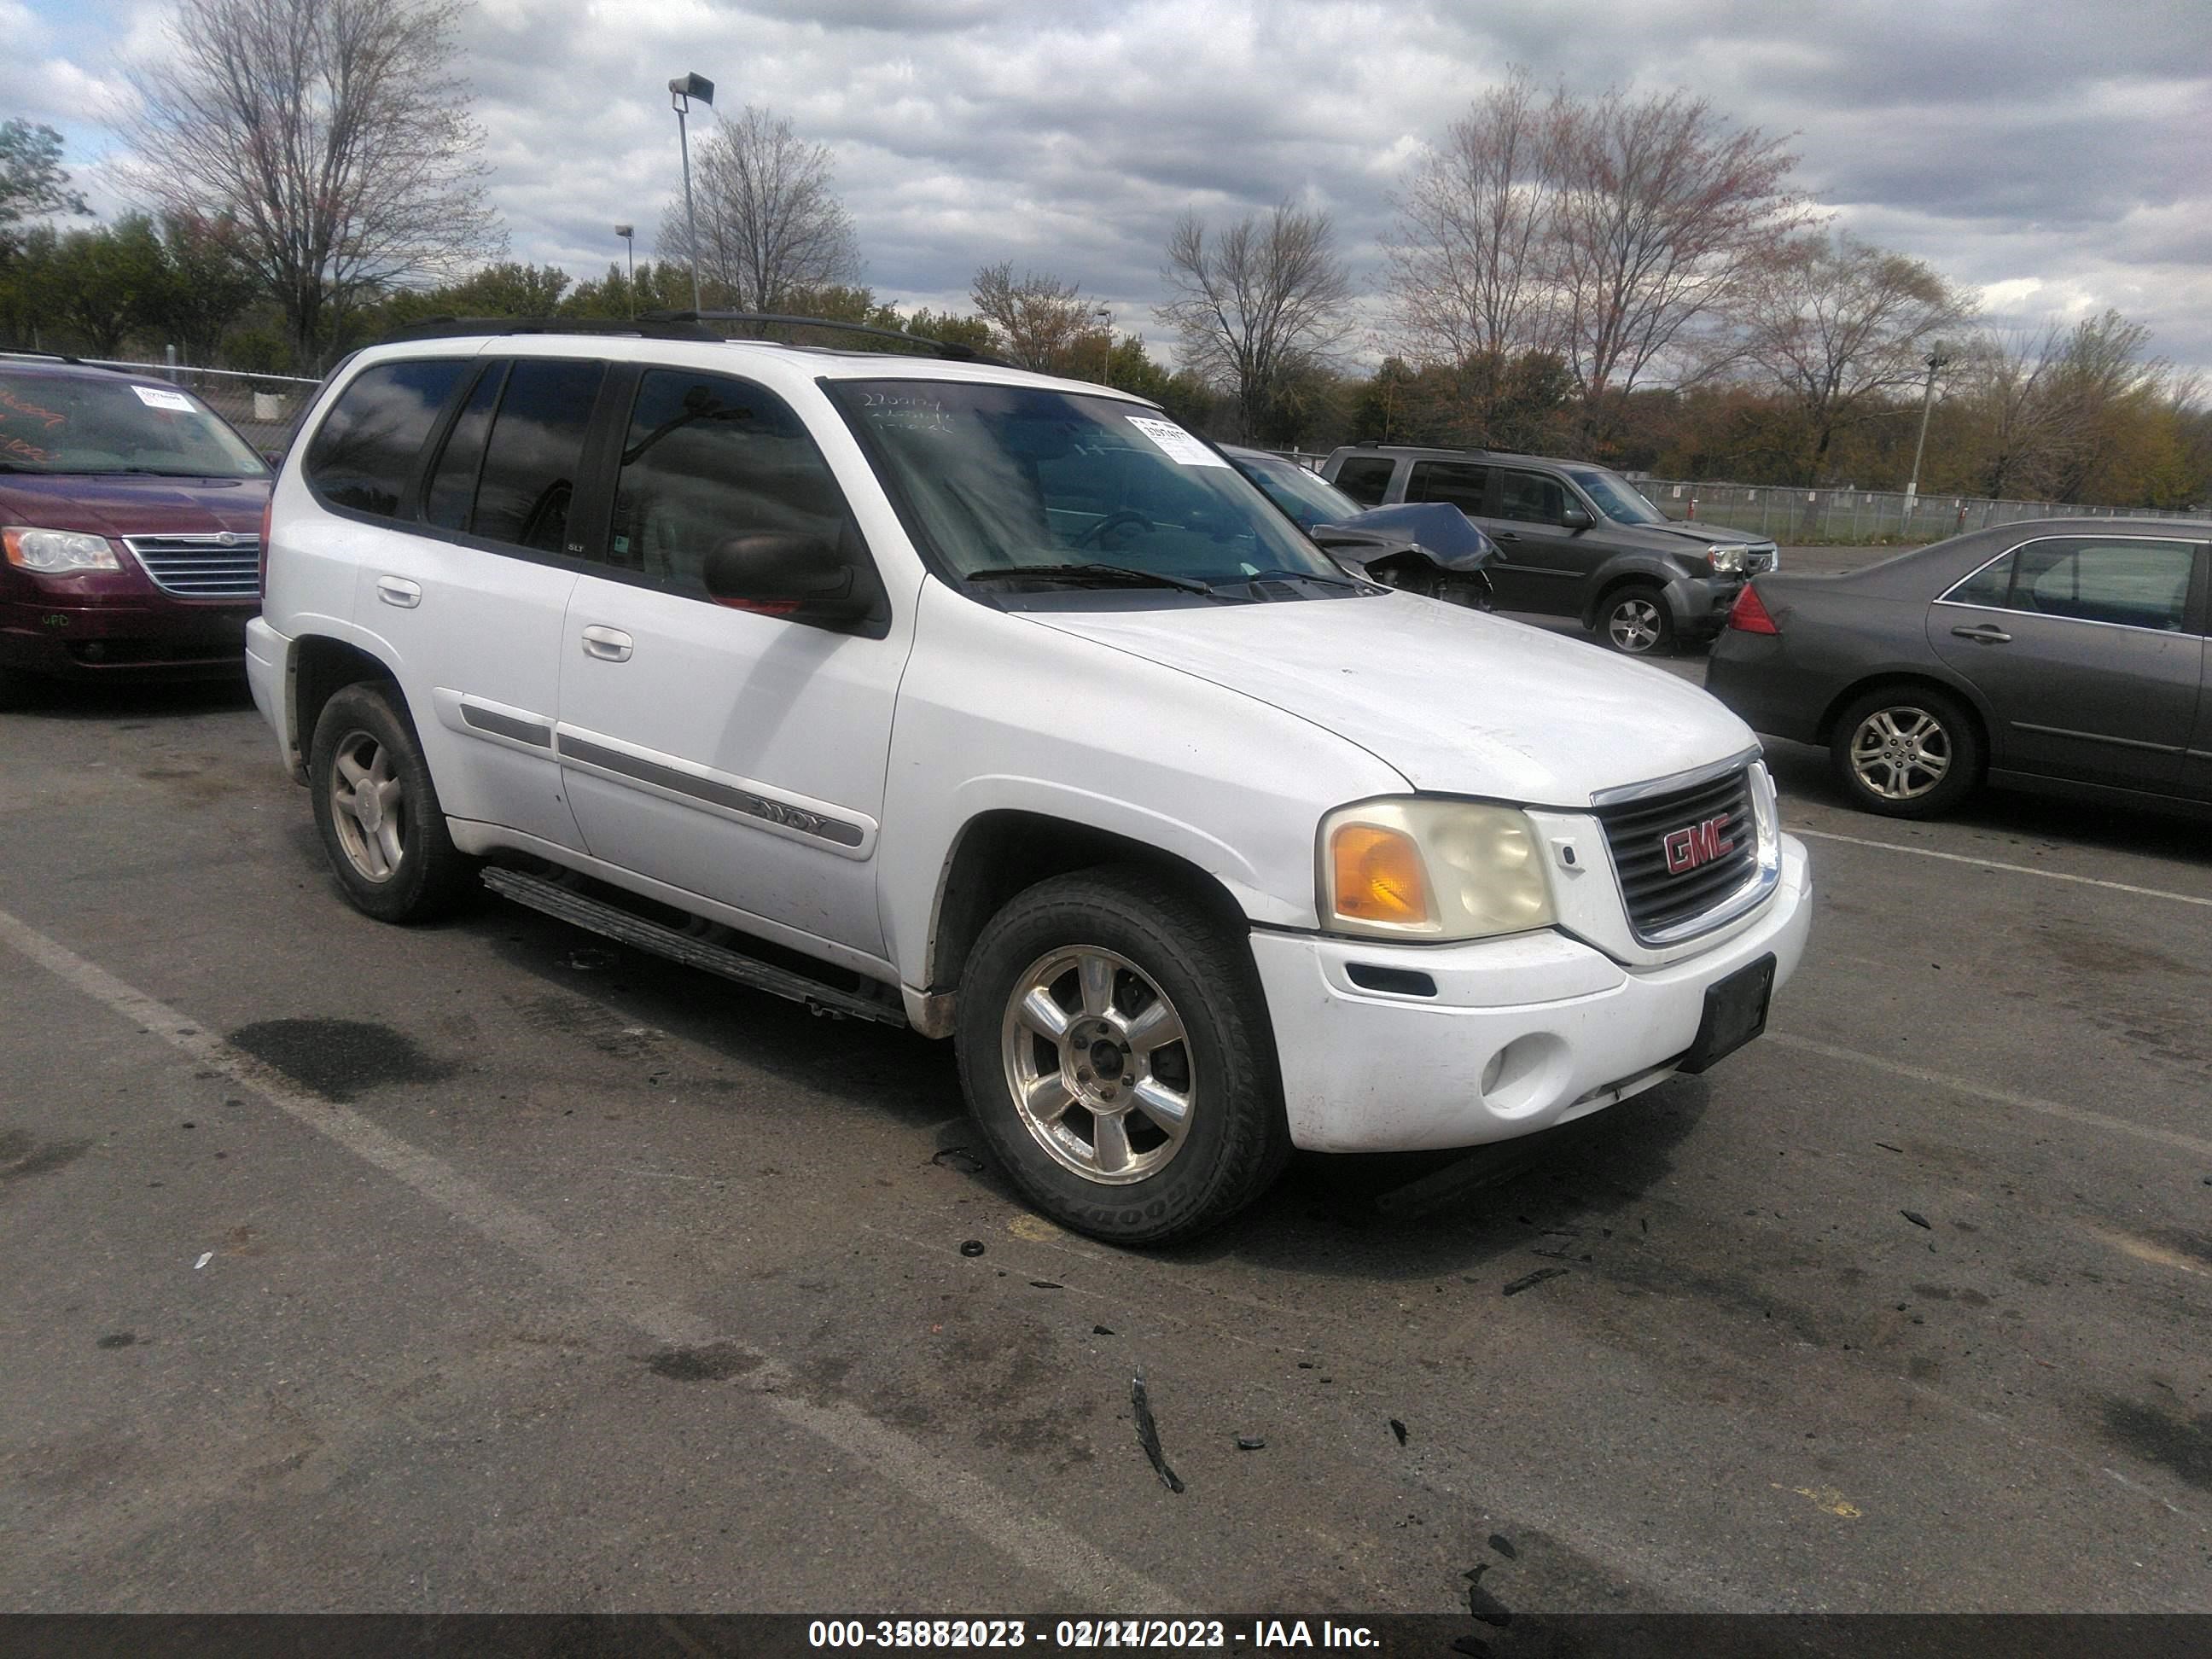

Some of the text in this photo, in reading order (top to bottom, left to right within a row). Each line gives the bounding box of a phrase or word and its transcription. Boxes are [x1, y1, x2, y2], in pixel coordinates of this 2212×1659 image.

[567, 544, 585, 553] SLT
[745, 795, 827, 832] ENVOY
[1664, 812, 1734, 874] GMC
